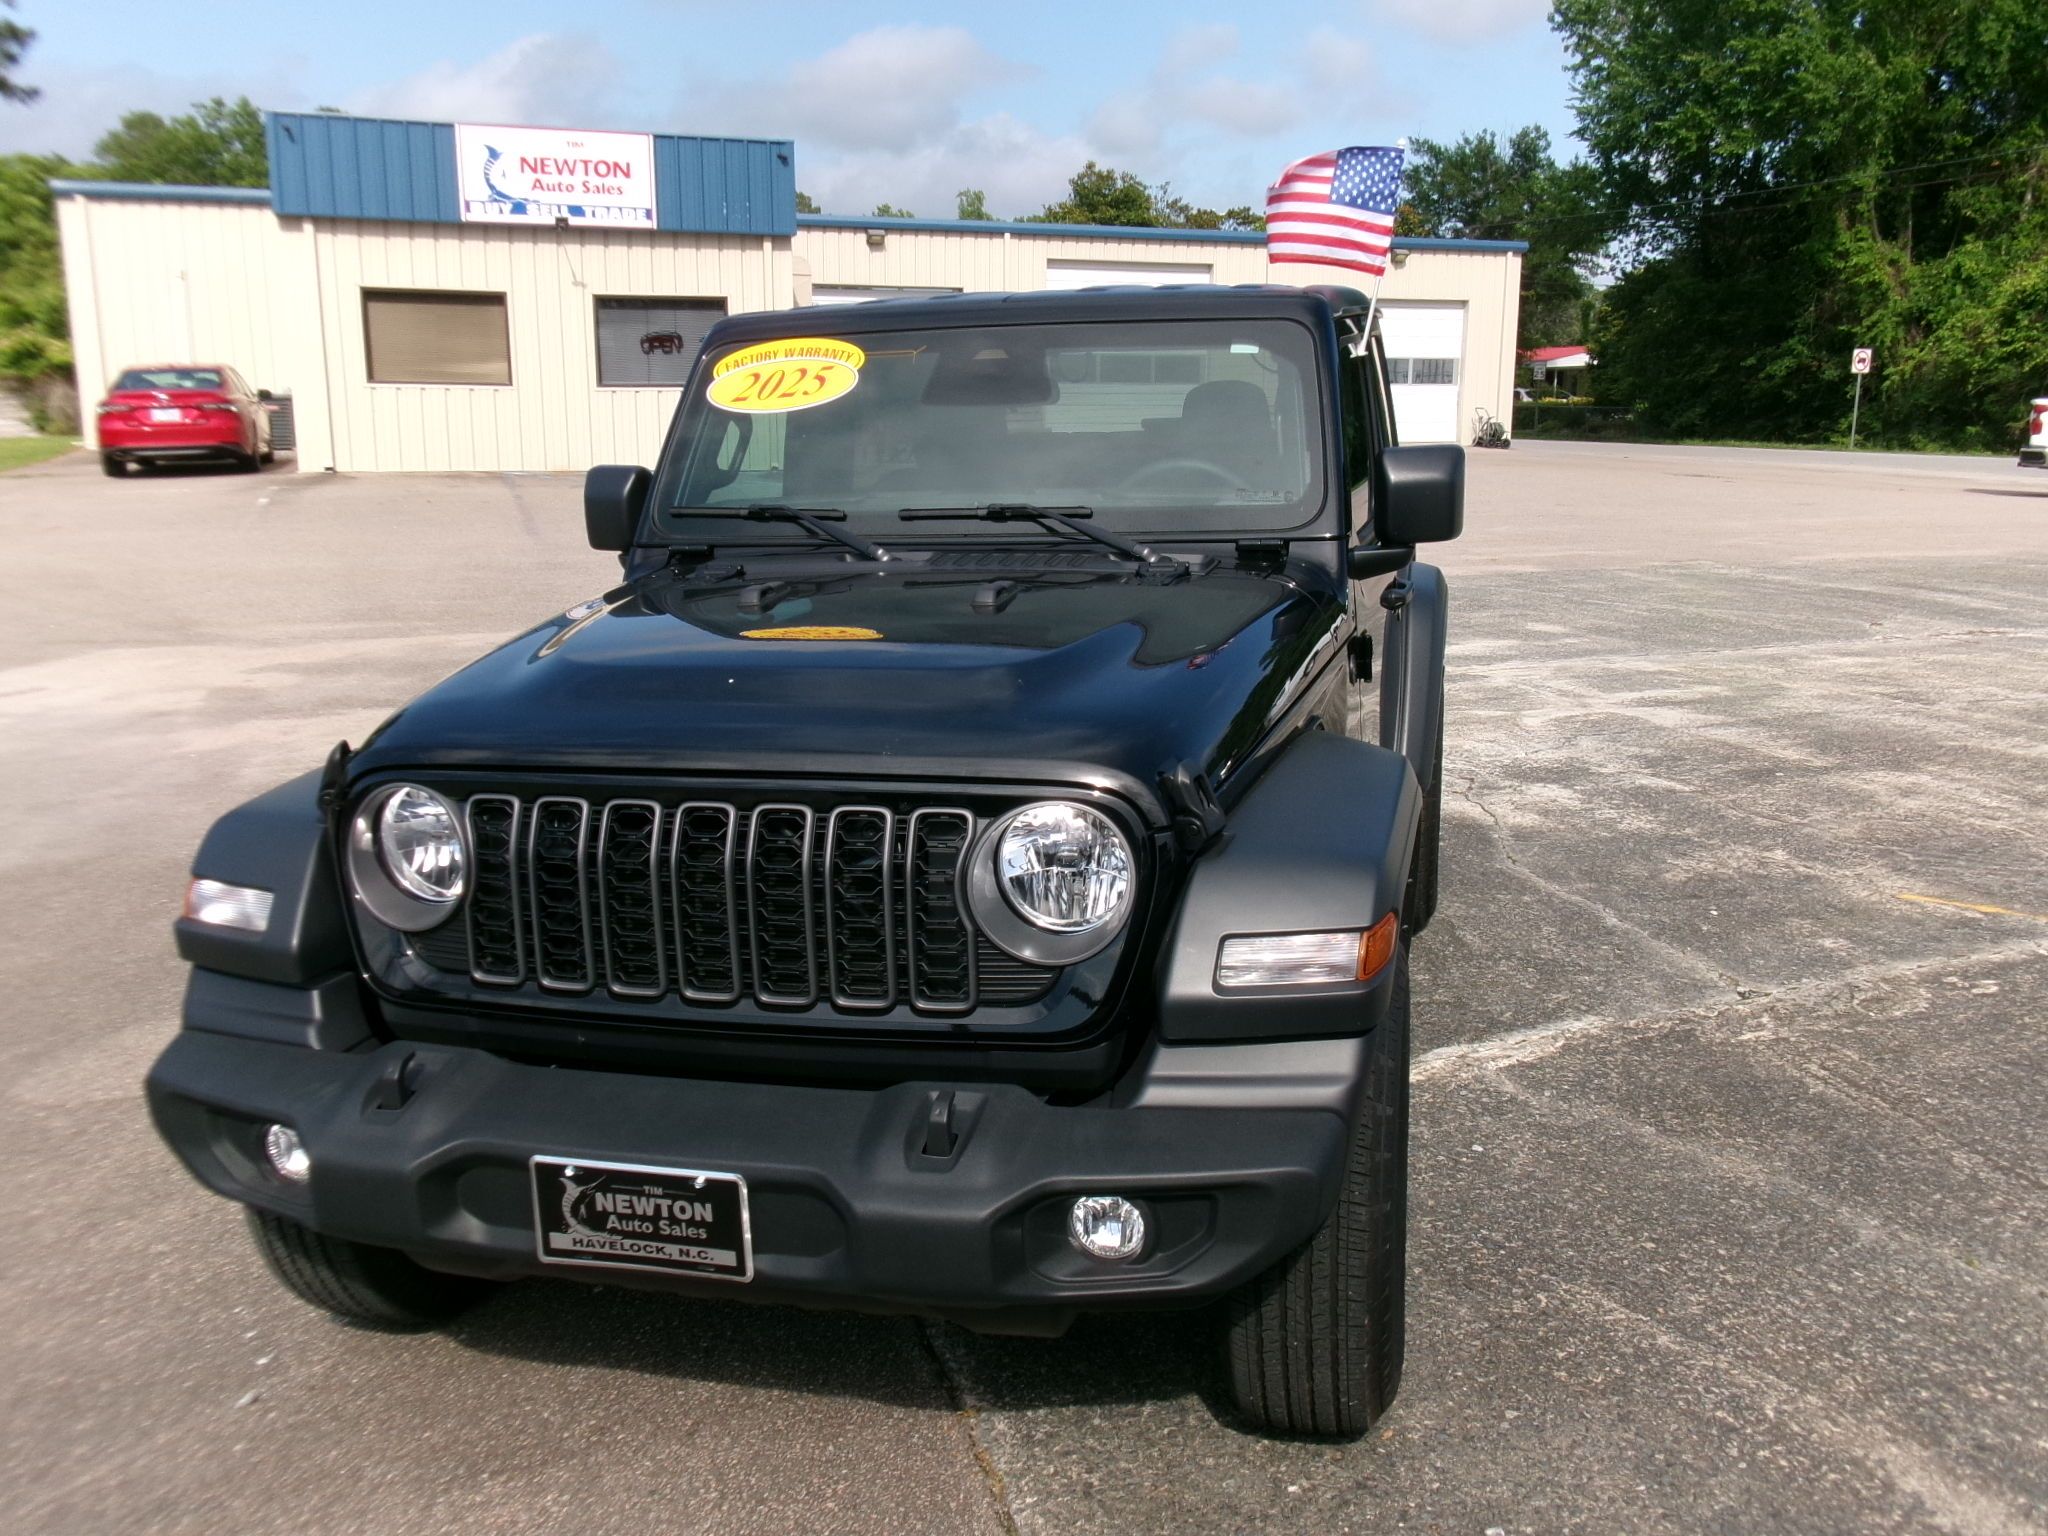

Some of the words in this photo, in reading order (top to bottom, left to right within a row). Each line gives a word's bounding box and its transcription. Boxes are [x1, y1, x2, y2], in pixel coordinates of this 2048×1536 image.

[520, 156, 632, 179] NEWTON
[531, 178, 575, 193] Auto
[582, 180, 624, 196] Sales
[469, 201, 512, 215] BUY
[526, 203, 570, 217] SELL
[584, 206, 648, 221] TRADE
[725, 350, 779, 372] FACTORY
[784, 347, 854, 362] WARRANTY
[731, 366, 834, 402] 2025
[643, 1185, 663, 1195] TIM
[595, 1192, 713, 1222] NEWTON
[606, 1214, 653, 1234] Auto
[659, 1219, 708, 1240] Sales
[572, 1237, 673, 1259] HAVELOCK,
[678, 1248, 715, 1261] N.C.
